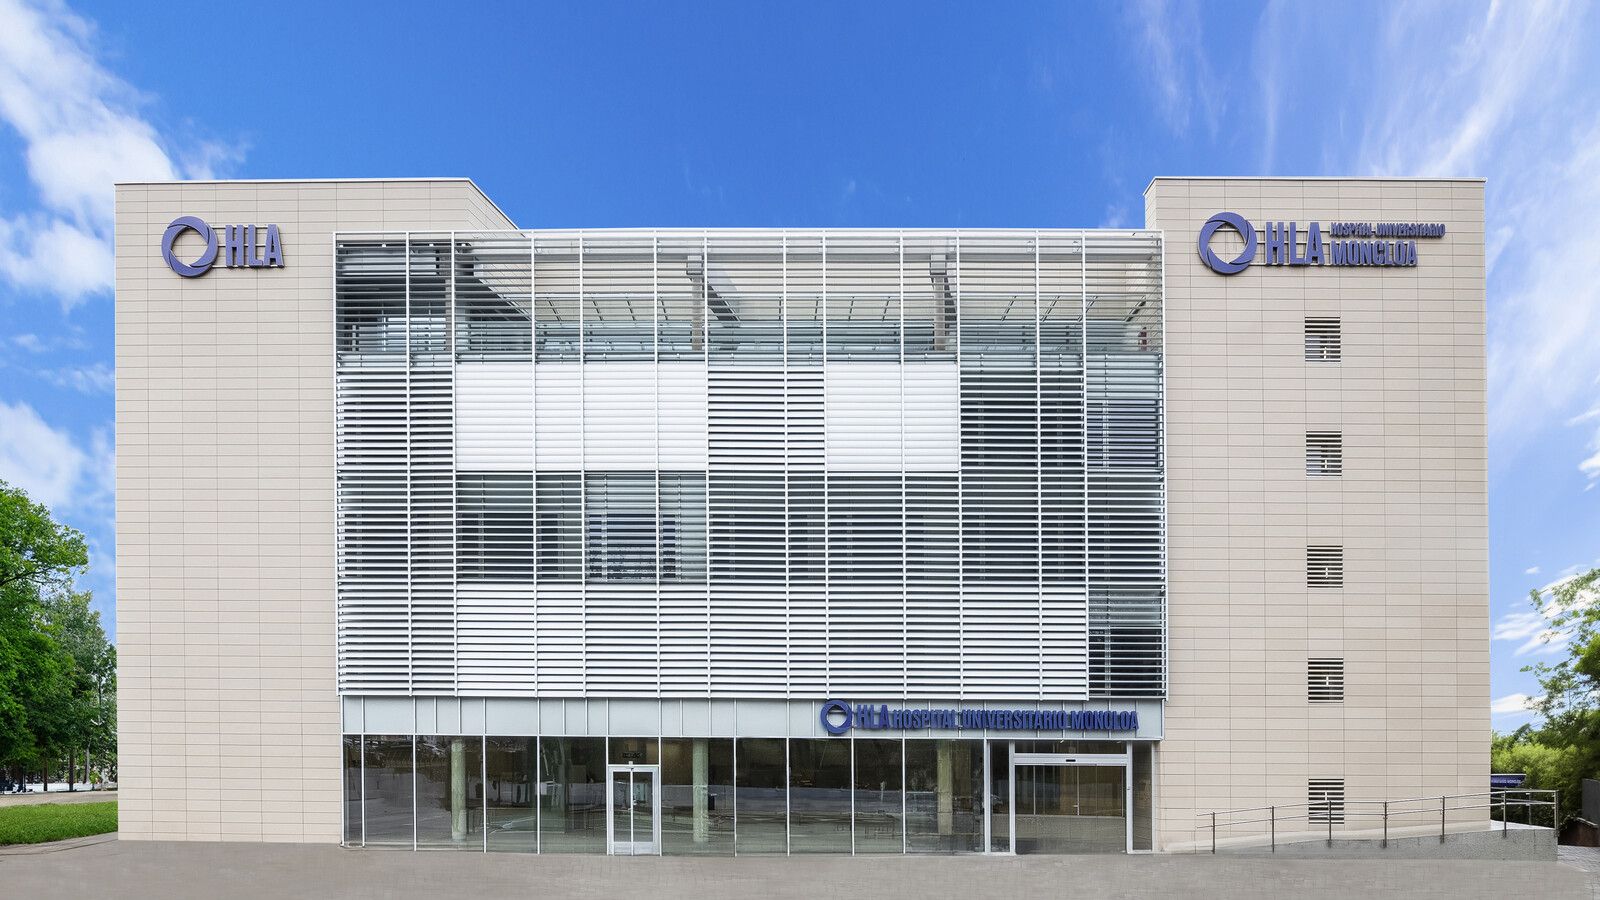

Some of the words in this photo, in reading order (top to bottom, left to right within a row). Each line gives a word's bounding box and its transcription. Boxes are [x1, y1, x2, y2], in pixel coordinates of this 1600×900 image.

[1265, 222, 1325, 266] HLA
[1330, 222, 1373, 238] HOSPITAL
[1375, 222, 1446, 239] UNIVERSITARIO
[225, 224, 284, 268] HLA
[1331, 240, 1418, 266] MONCLOA
[857, 704, 890, 729] HLA
[893, 709, 958, 730] HOSPITAL
[961, 709, 1069, 730] UNIVERSITARIO
[1070, 710, 1139, 731] MONCLOA
